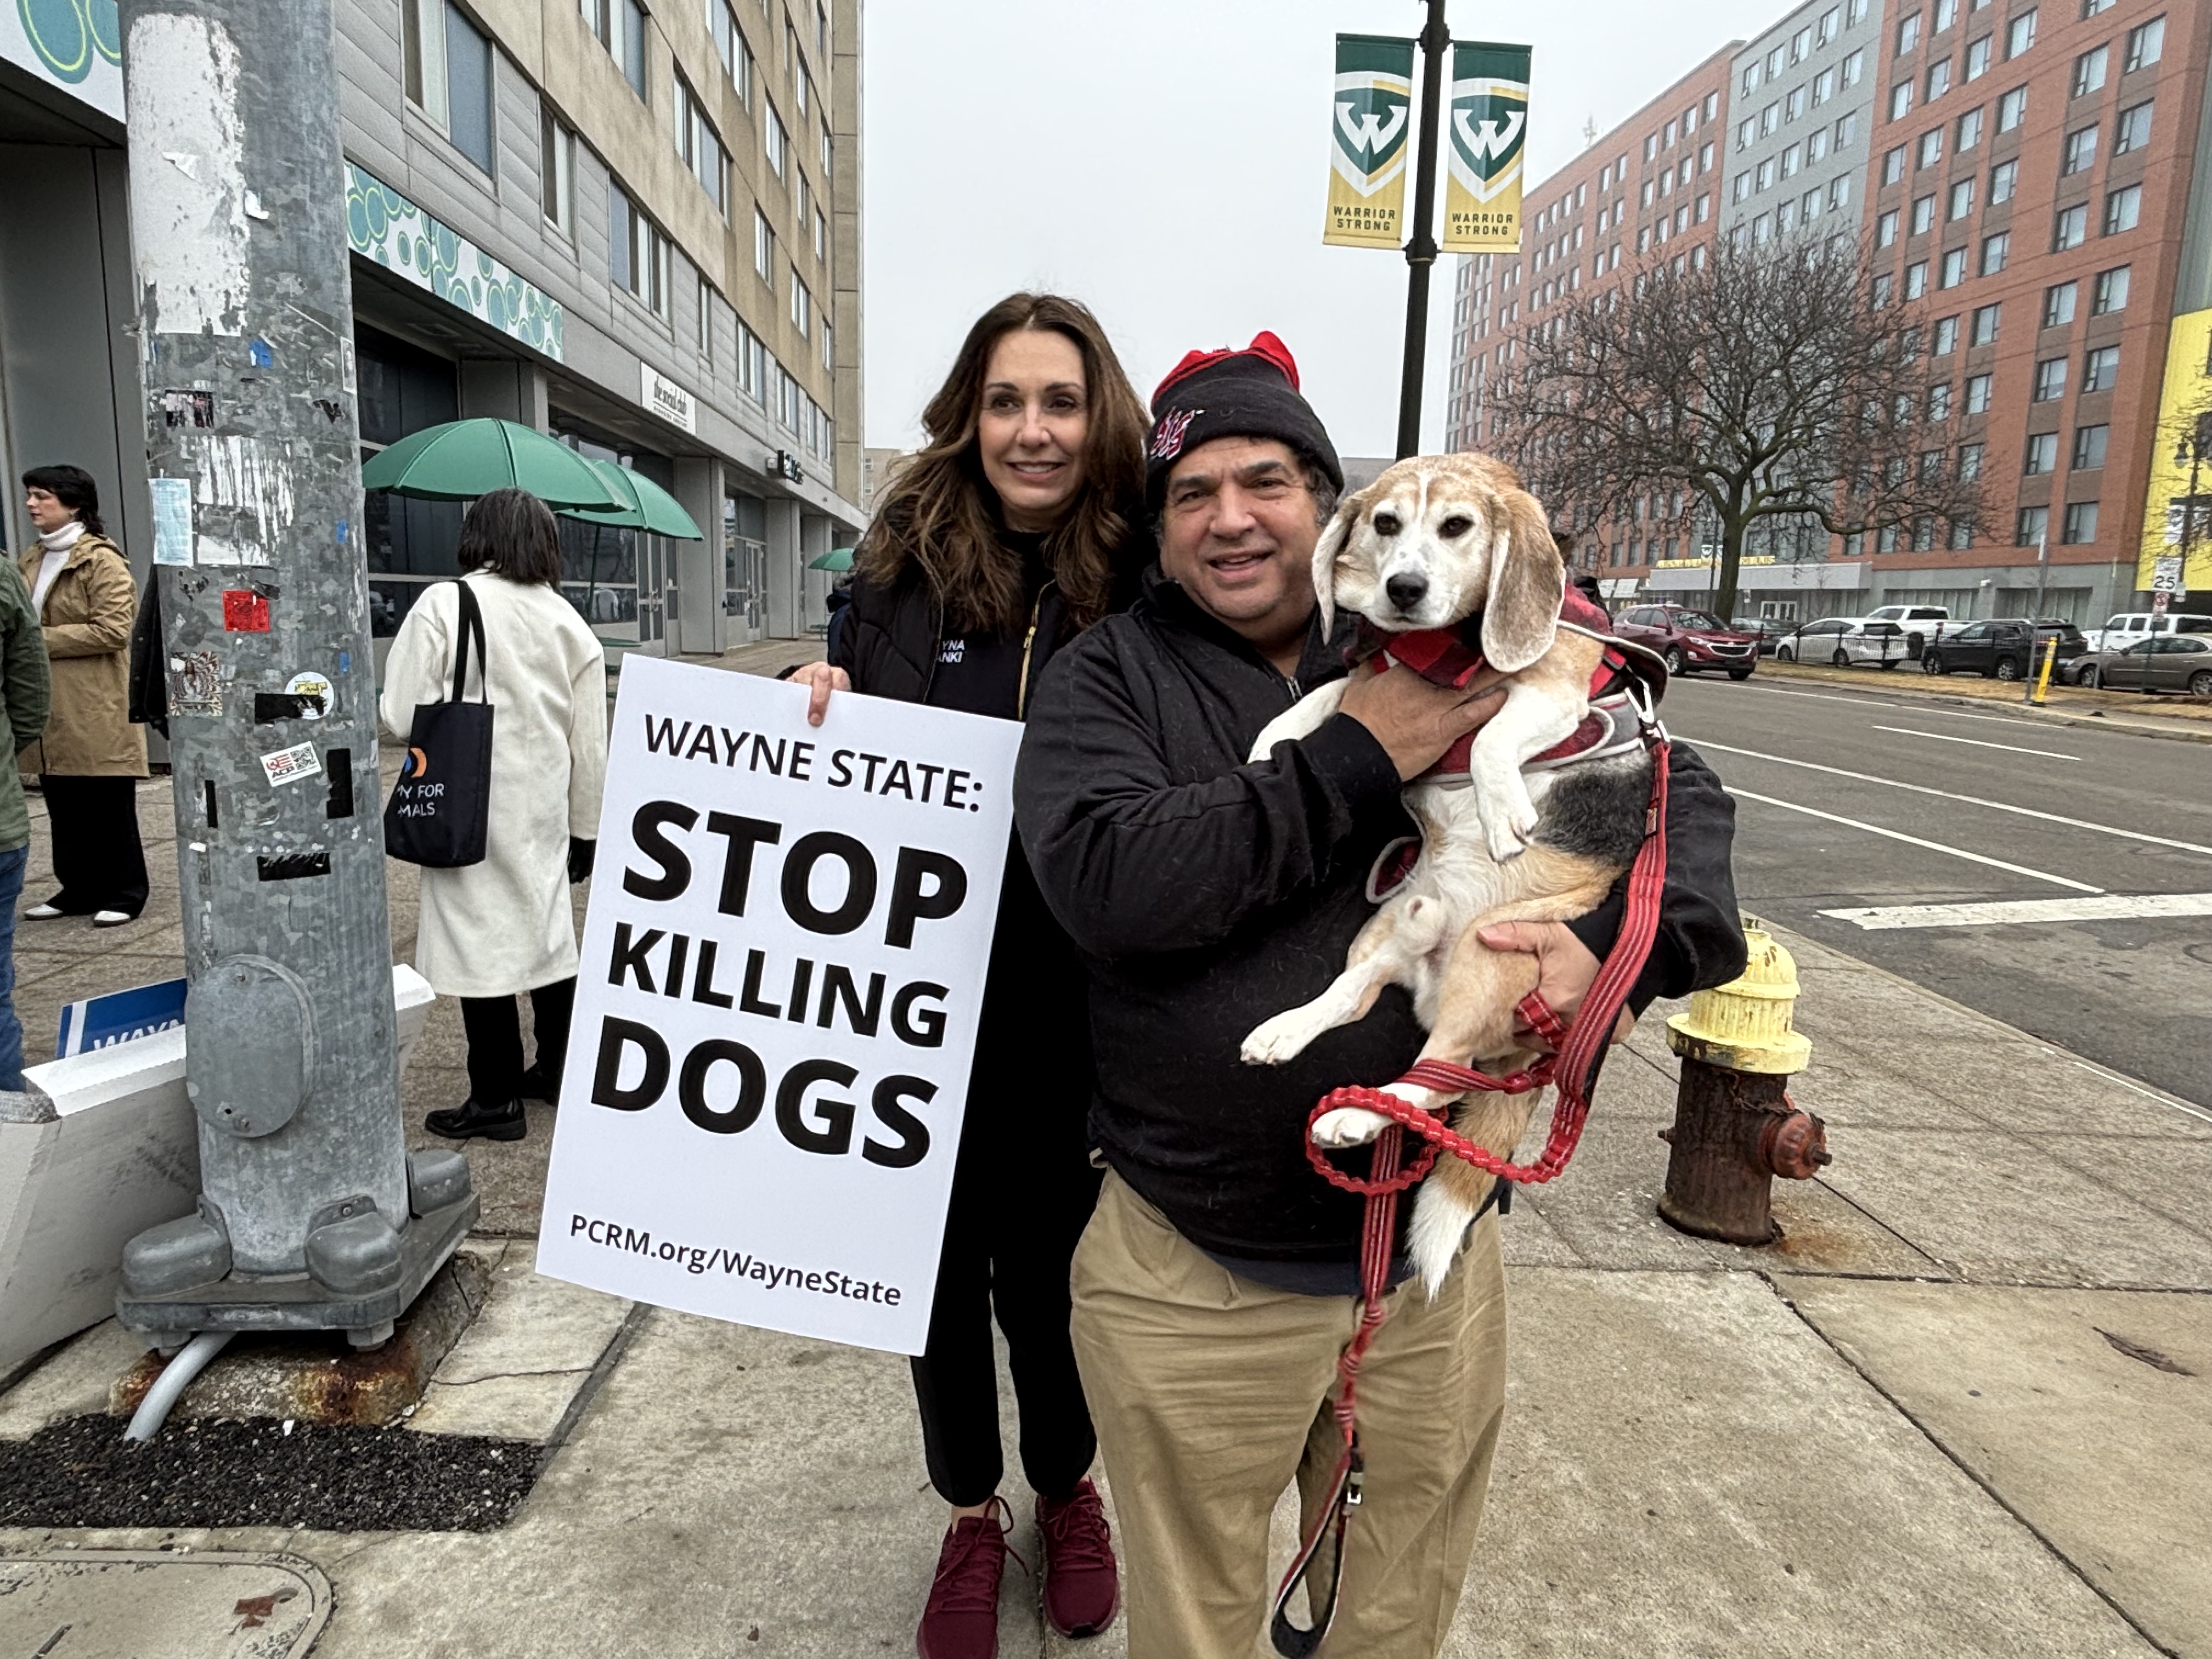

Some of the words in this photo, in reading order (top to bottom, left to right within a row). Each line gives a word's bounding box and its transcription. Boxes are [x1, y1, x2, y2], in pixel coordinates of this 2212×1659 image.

[1333, 205, 1396, 219] WARRIOR
[1452, 213, 1513, 224] WARRIOR
[1336, 218, 1390, 231] STRONG
[1455, 225, 1508, 236] STRONG
[2154, 575, 2176, 589] 25
[645, 714, 816, 782] WAYNE
[827, 749, 983, 812] STATE:
[417, 783, 444, 799] FOR
[622, 800, 968, 950] STOP
[608, 922, 950, 1048] KILLING
[590, 1015, 939, 1169] DOGS
[571, 1215, 901, 1306] PCRM.org/WayneState
